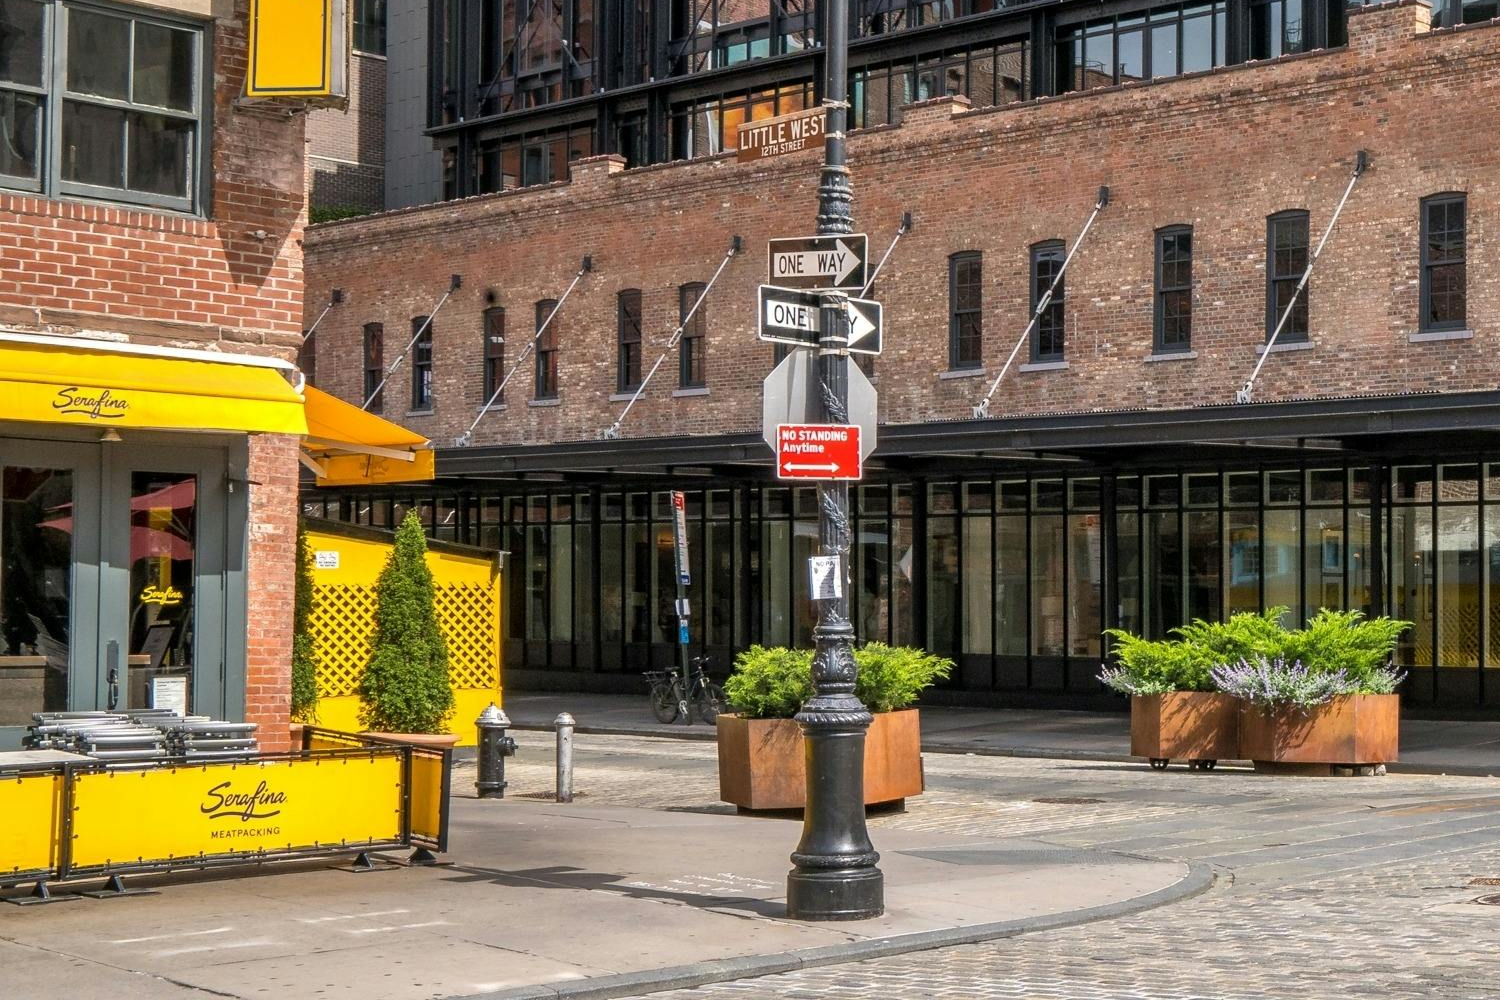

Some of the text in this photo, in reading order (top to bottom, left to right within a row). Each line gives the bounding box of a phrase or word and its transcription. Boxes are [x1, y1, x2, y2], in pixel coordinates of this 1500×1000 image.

[740, 114, 827, 151] LITTLE WEST
[761, 138, 806, 157] 12TH STREET
[778, 252, 846, 275] ONE WAY
[774, 304, 807, 327] ONE
[52, 387, 129, 419] Serafina
[782, 429, 848, 441] NO STANDING
[783, 442, 825, 454] Anytime
[140, 585, 183, 605] Serafina
[200, 780, 287, 822] Serafina
[211, 826, 281, 839] MEATPACKING
